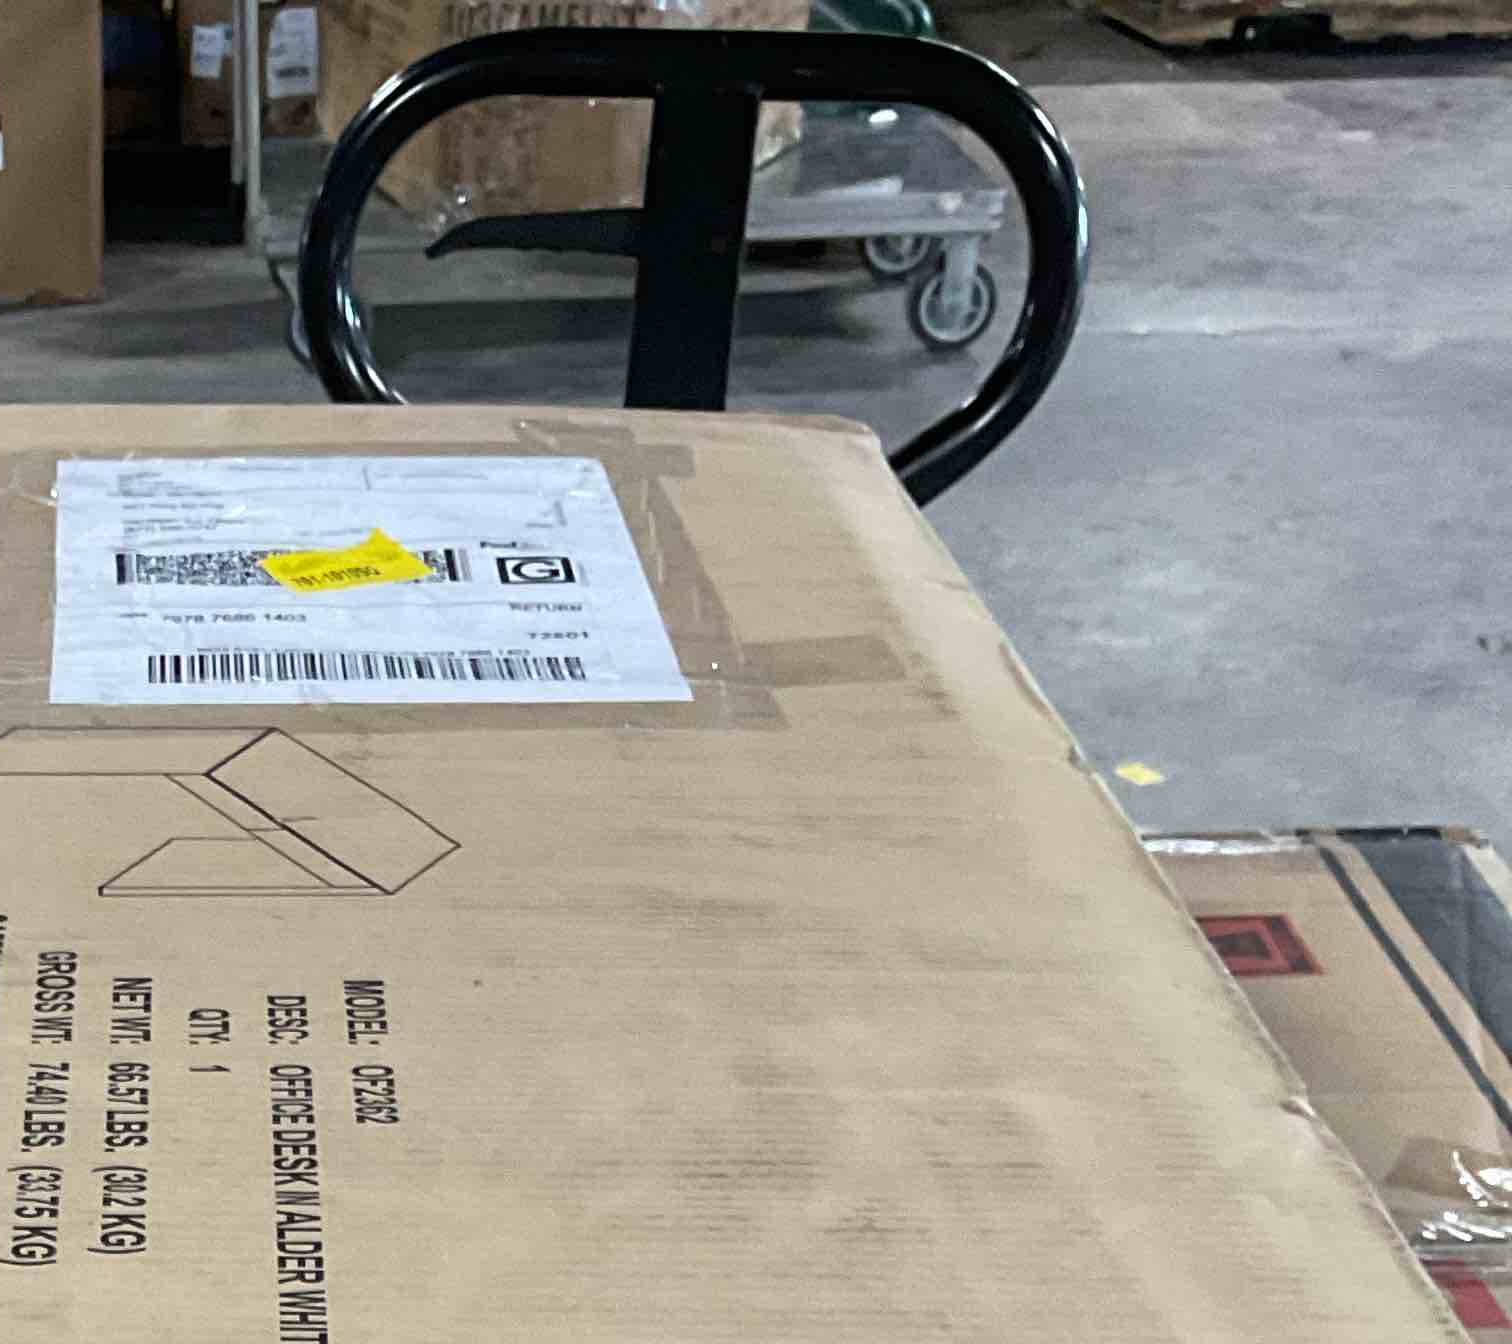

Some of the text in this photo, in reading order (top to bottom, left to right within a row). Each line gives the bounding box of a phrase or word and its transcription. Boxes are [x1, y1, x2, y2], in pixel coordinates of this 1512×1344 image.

[511, 559, 560, 581] G
[34, 951, 78, 1013] GROSS
[112, 977, 152, 1013] NET
[31, 1016, 73, 1045] WT:
[109, 1016, 151, 1045] WT:
[188, 1008, 231, 1073] QTY: 1
[267, 995, 309, 1045] DESC:
[344, 980, 400, 1124] MODEL: OF2362
[26, 1062, 70, 1105] 74.40
[107, 1062, 150, 1106] 66.57
[269, 1064, 315, 1125] OFFICE
[273, 1129, 319, 1186] DESK
[7, 1165, 64, 1219] (33.75
[90, 1166, 148, 1207] (30.2
[275, 1191, 321, 1206] IN
[86, 1213, 147, 1255] KG)
[276, 1210, 325, 1284] ALDER
